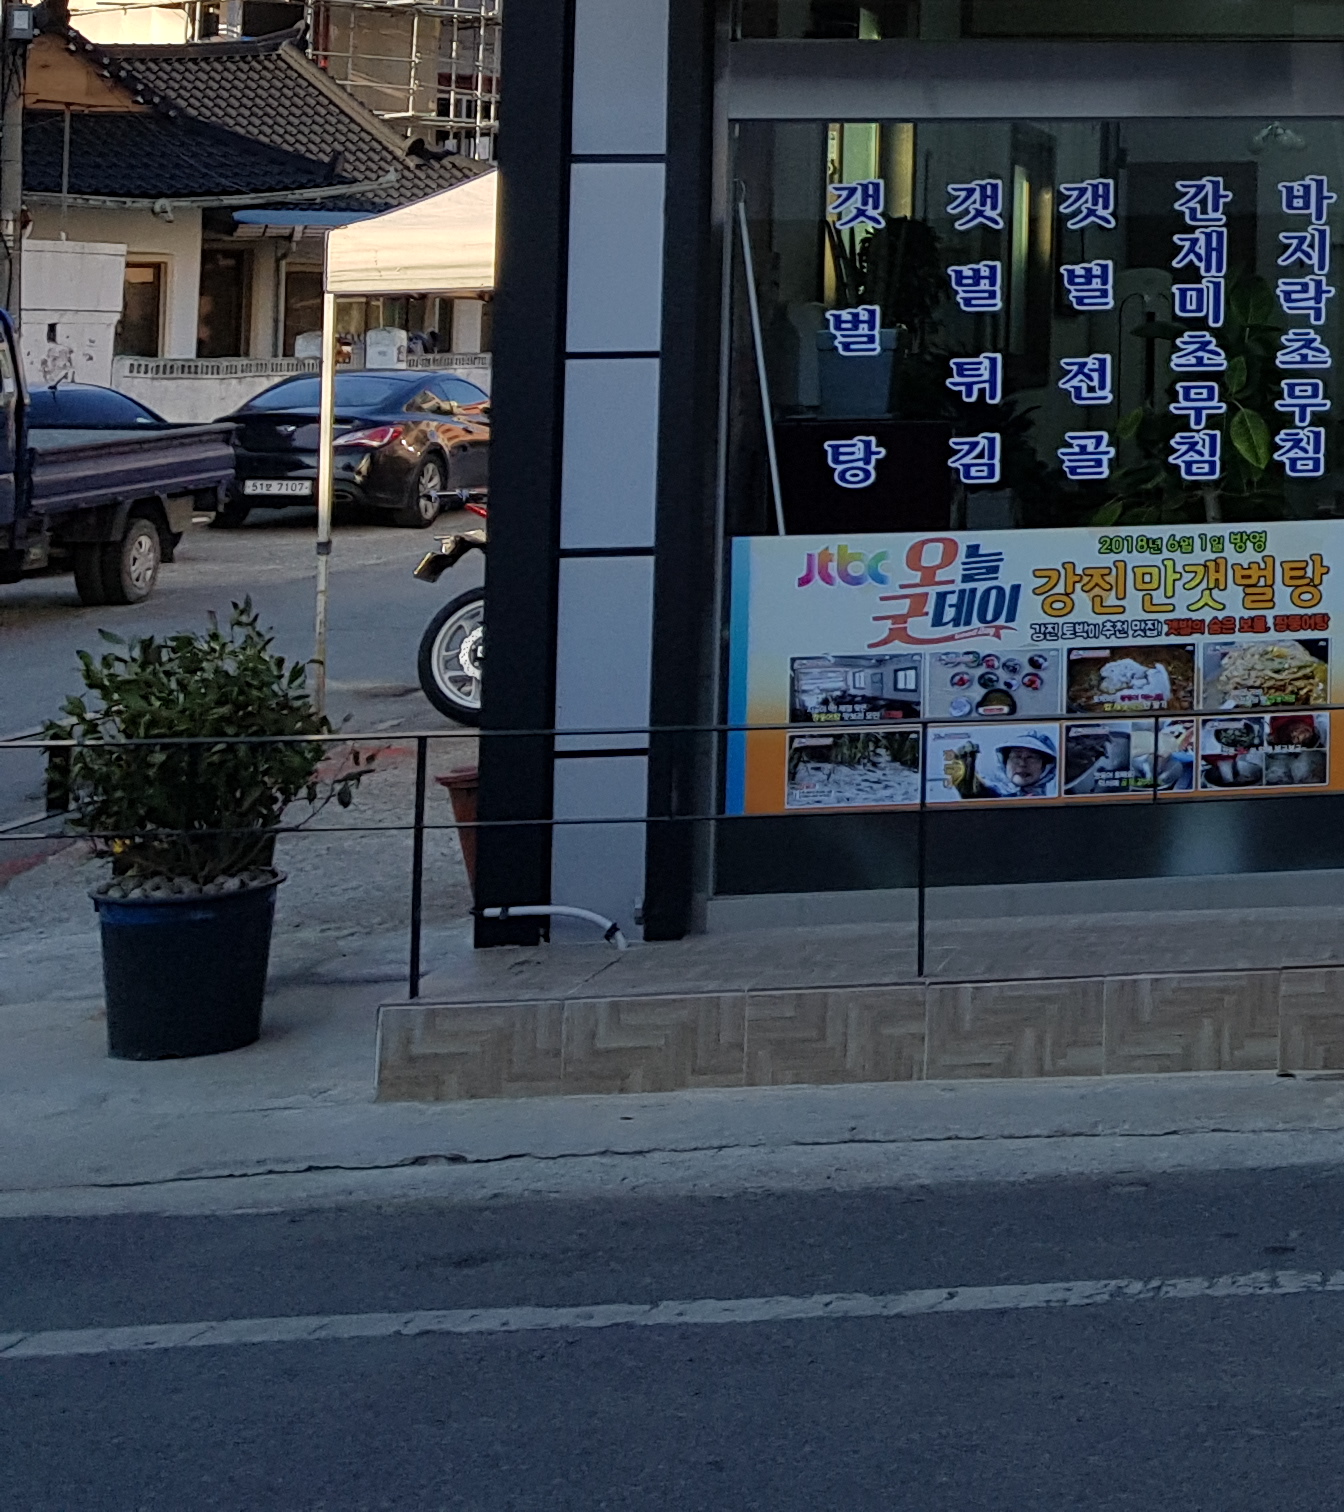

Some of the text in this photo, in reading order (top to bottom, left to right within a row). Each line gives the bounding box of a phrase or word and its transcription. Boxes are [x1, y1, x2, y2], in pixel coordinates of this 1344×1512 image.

[825, 178, 886, 488] 갯벌탕
[945, 177, 1003, 484] 갯벌튀김
[1056, 177, 1116, 481] 갯벌전골
[1167, 174, 1232, 481] 간재미초무침
[1273, 173, 1337, 479] 바지락초무침
[866, 583, 1023, 649] 굿데이
[898, 536, 1005, 590] 오늘
[1030, 623, 1059, 642] 강진
[1060, 621, 1100, 640] 토박이
[1101, 619, 1129, 639] 추천
[1031, 552, 1331, 618] 강진만갯벌탕
[1098, 535, 1163, 555] 2018년
[1228, 531, 1268, 553] 방영
